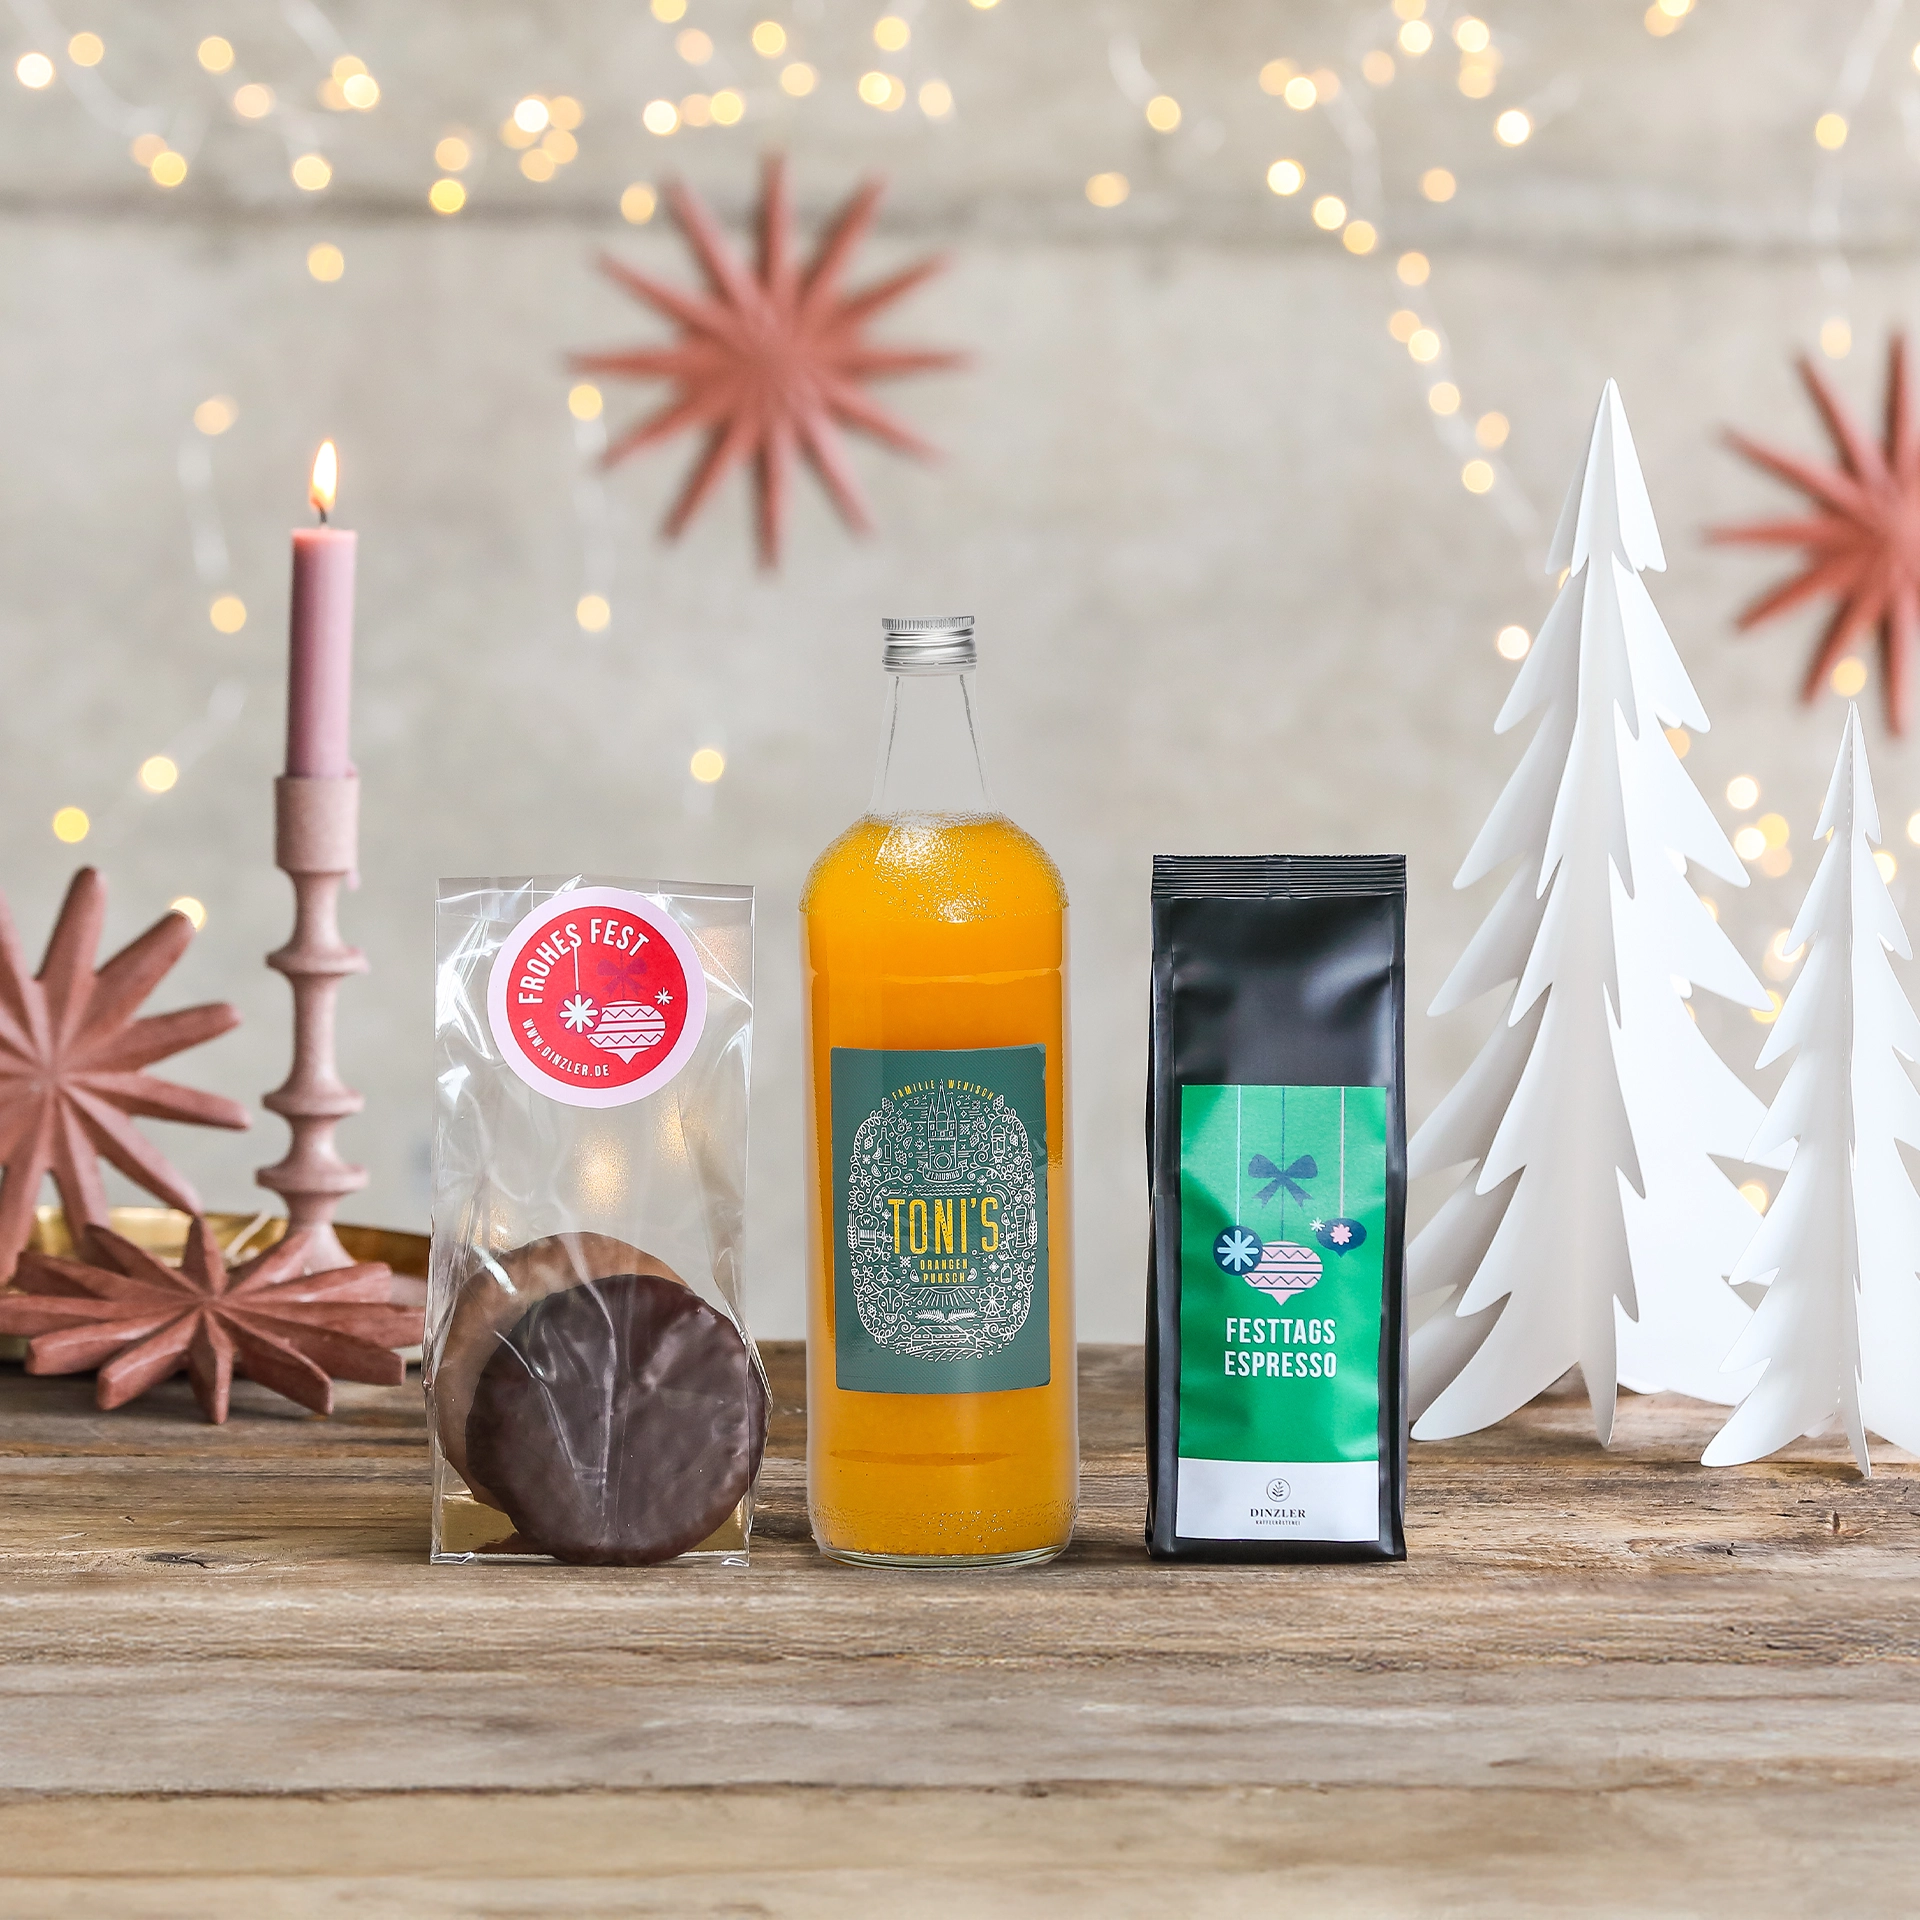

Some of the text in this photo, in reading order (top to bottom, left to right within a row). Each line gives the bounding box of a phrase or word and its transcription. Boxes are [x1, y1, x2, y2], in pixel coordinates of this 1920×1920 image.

[518, 918, 649, 1004] FROHES FEST
[522, 1018, 610, 1077] WWW.DINZLER.DE
[892, 1079, 994, 1101] FAMILIE WENISCH
[887, 1197, 999, 1255] TONI'S
[920, 1258, 968, 1270] ORANGEN
[923, 1272, 965, 1284] PUNSCH
[1226, 1317, 1337, 1345] FESTTAGS
[1224, 1351, 1338, 1378] ESPRESSO
[1250, 1508, 1306, 1518] DINZLER
